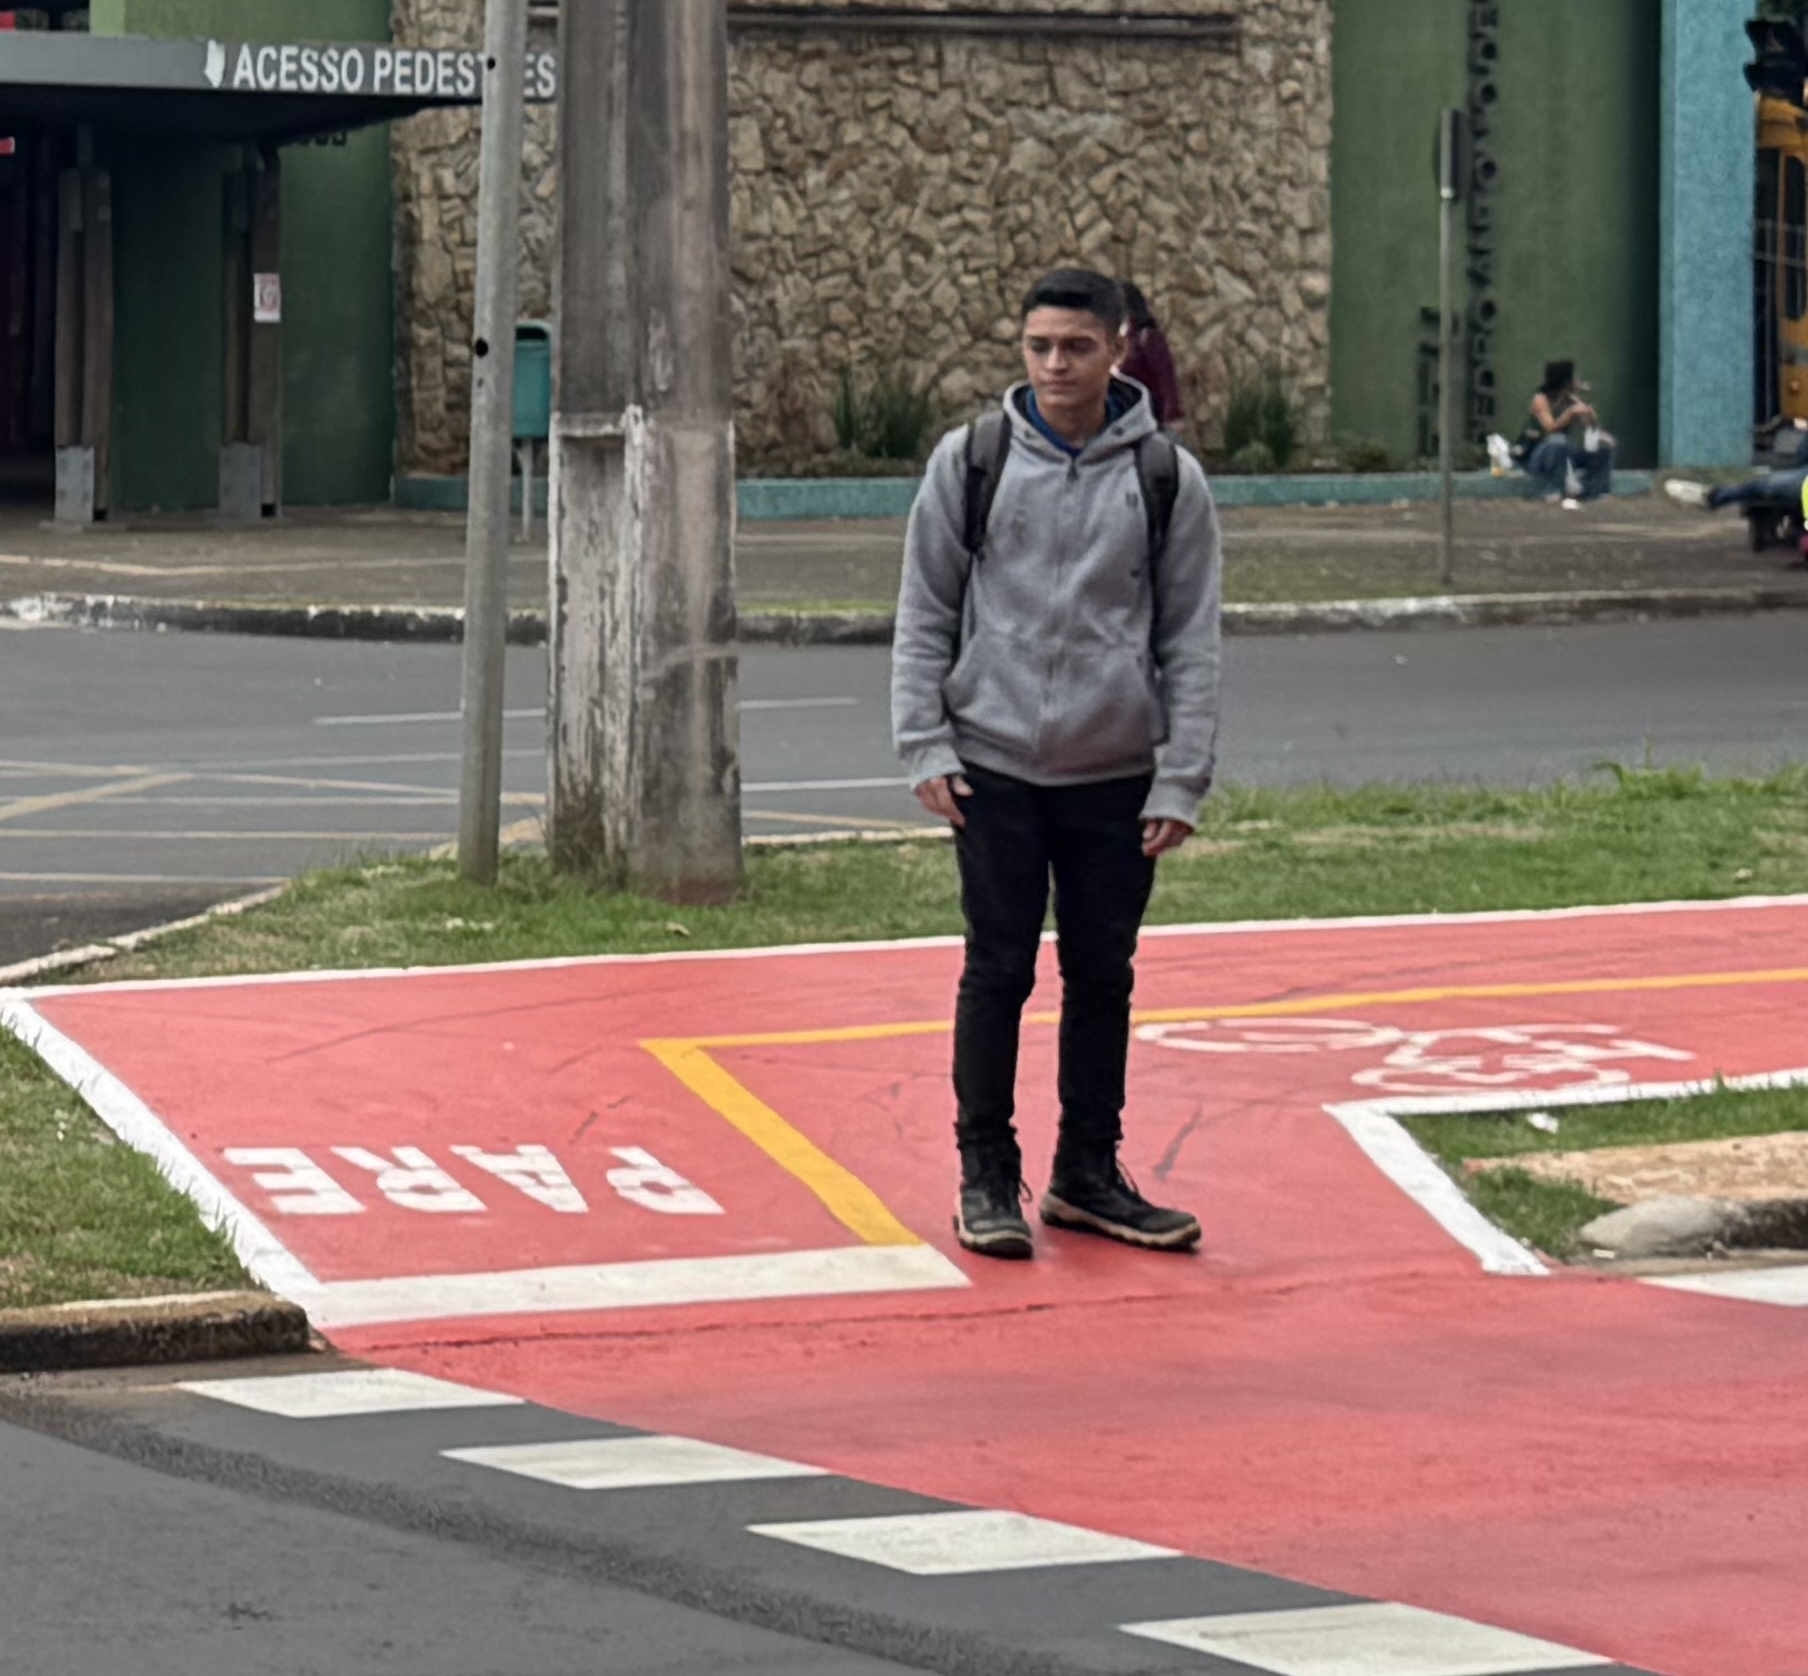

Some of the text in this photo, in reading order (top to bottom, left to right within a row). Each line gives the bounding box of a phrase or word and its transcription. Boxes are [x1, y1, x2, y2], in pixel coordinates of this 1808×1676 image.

[233, 43, 556, 98] ACESSO PEDESES
[224, 1145, 725, 1214] PARE
